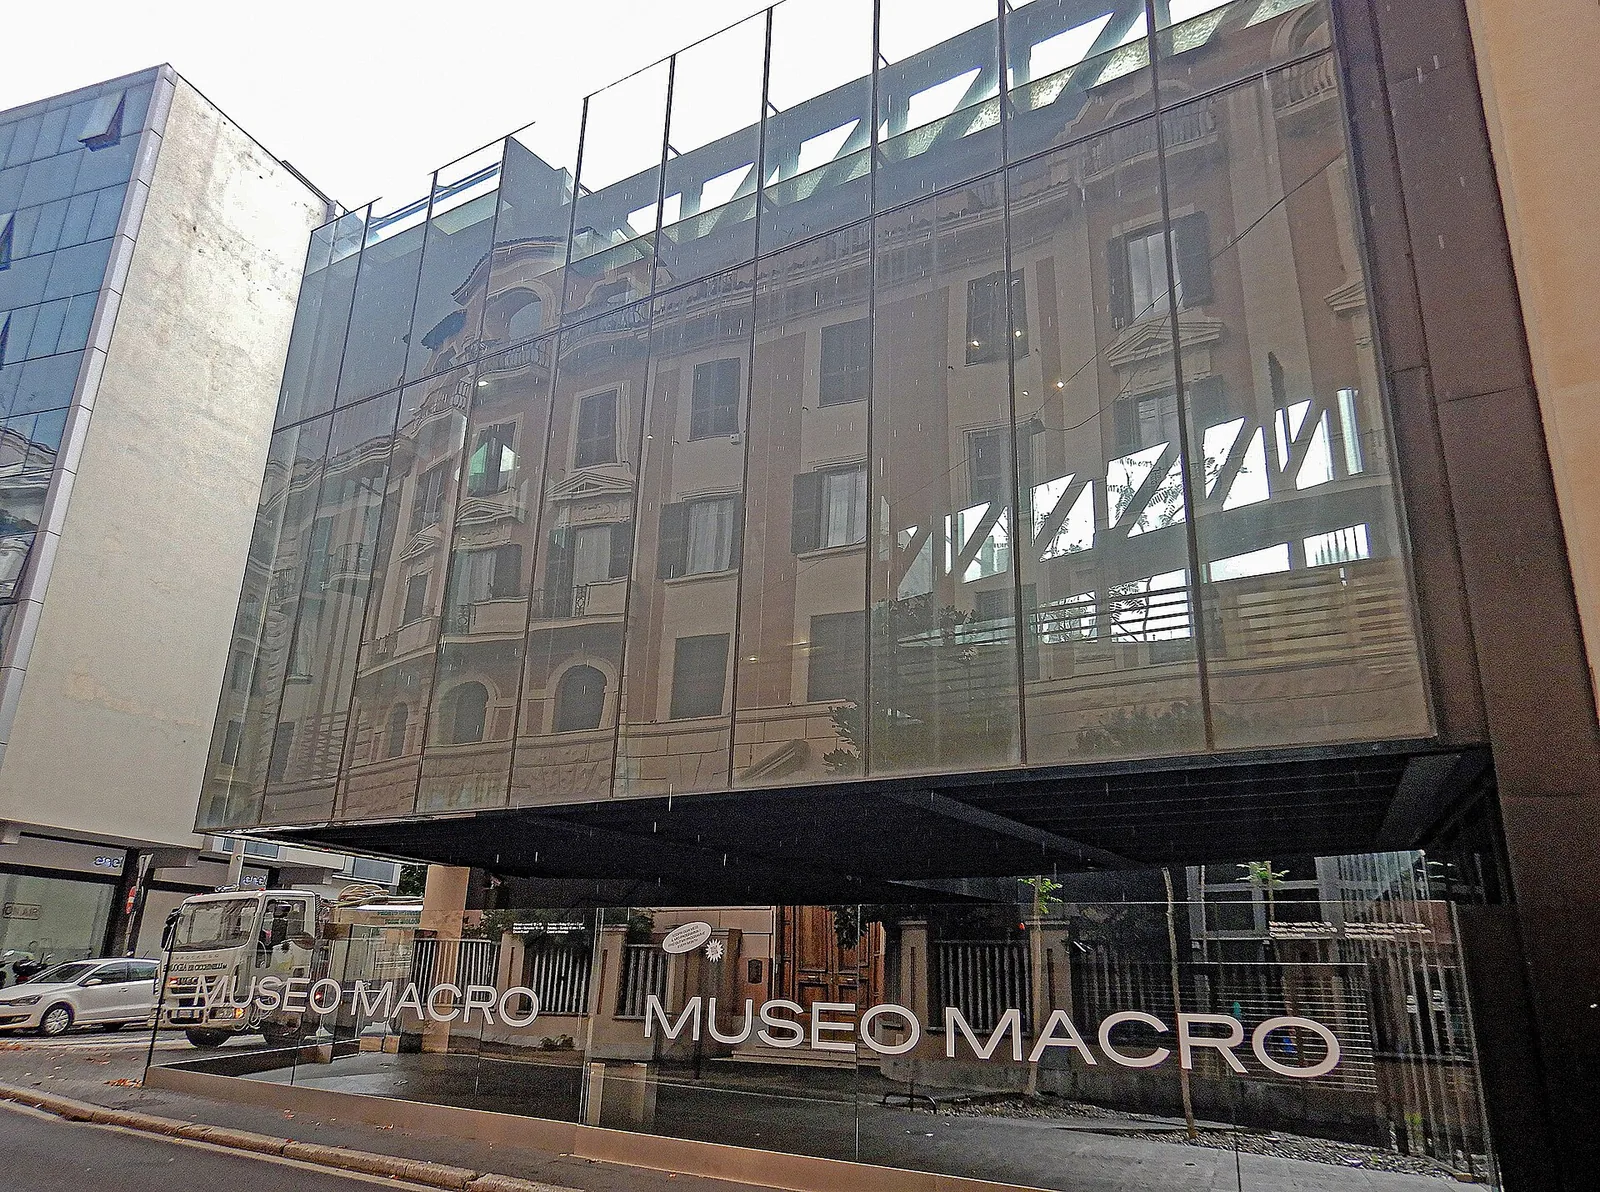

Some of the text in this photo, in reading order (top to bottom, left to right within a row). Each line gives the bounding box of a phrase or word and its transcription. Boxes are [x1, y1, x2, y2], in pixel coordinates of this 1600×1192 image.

[193, 975, 541, 1028] MUSEO MACRO
[643, 993, 1342, 1078] MUSEO MACRO
